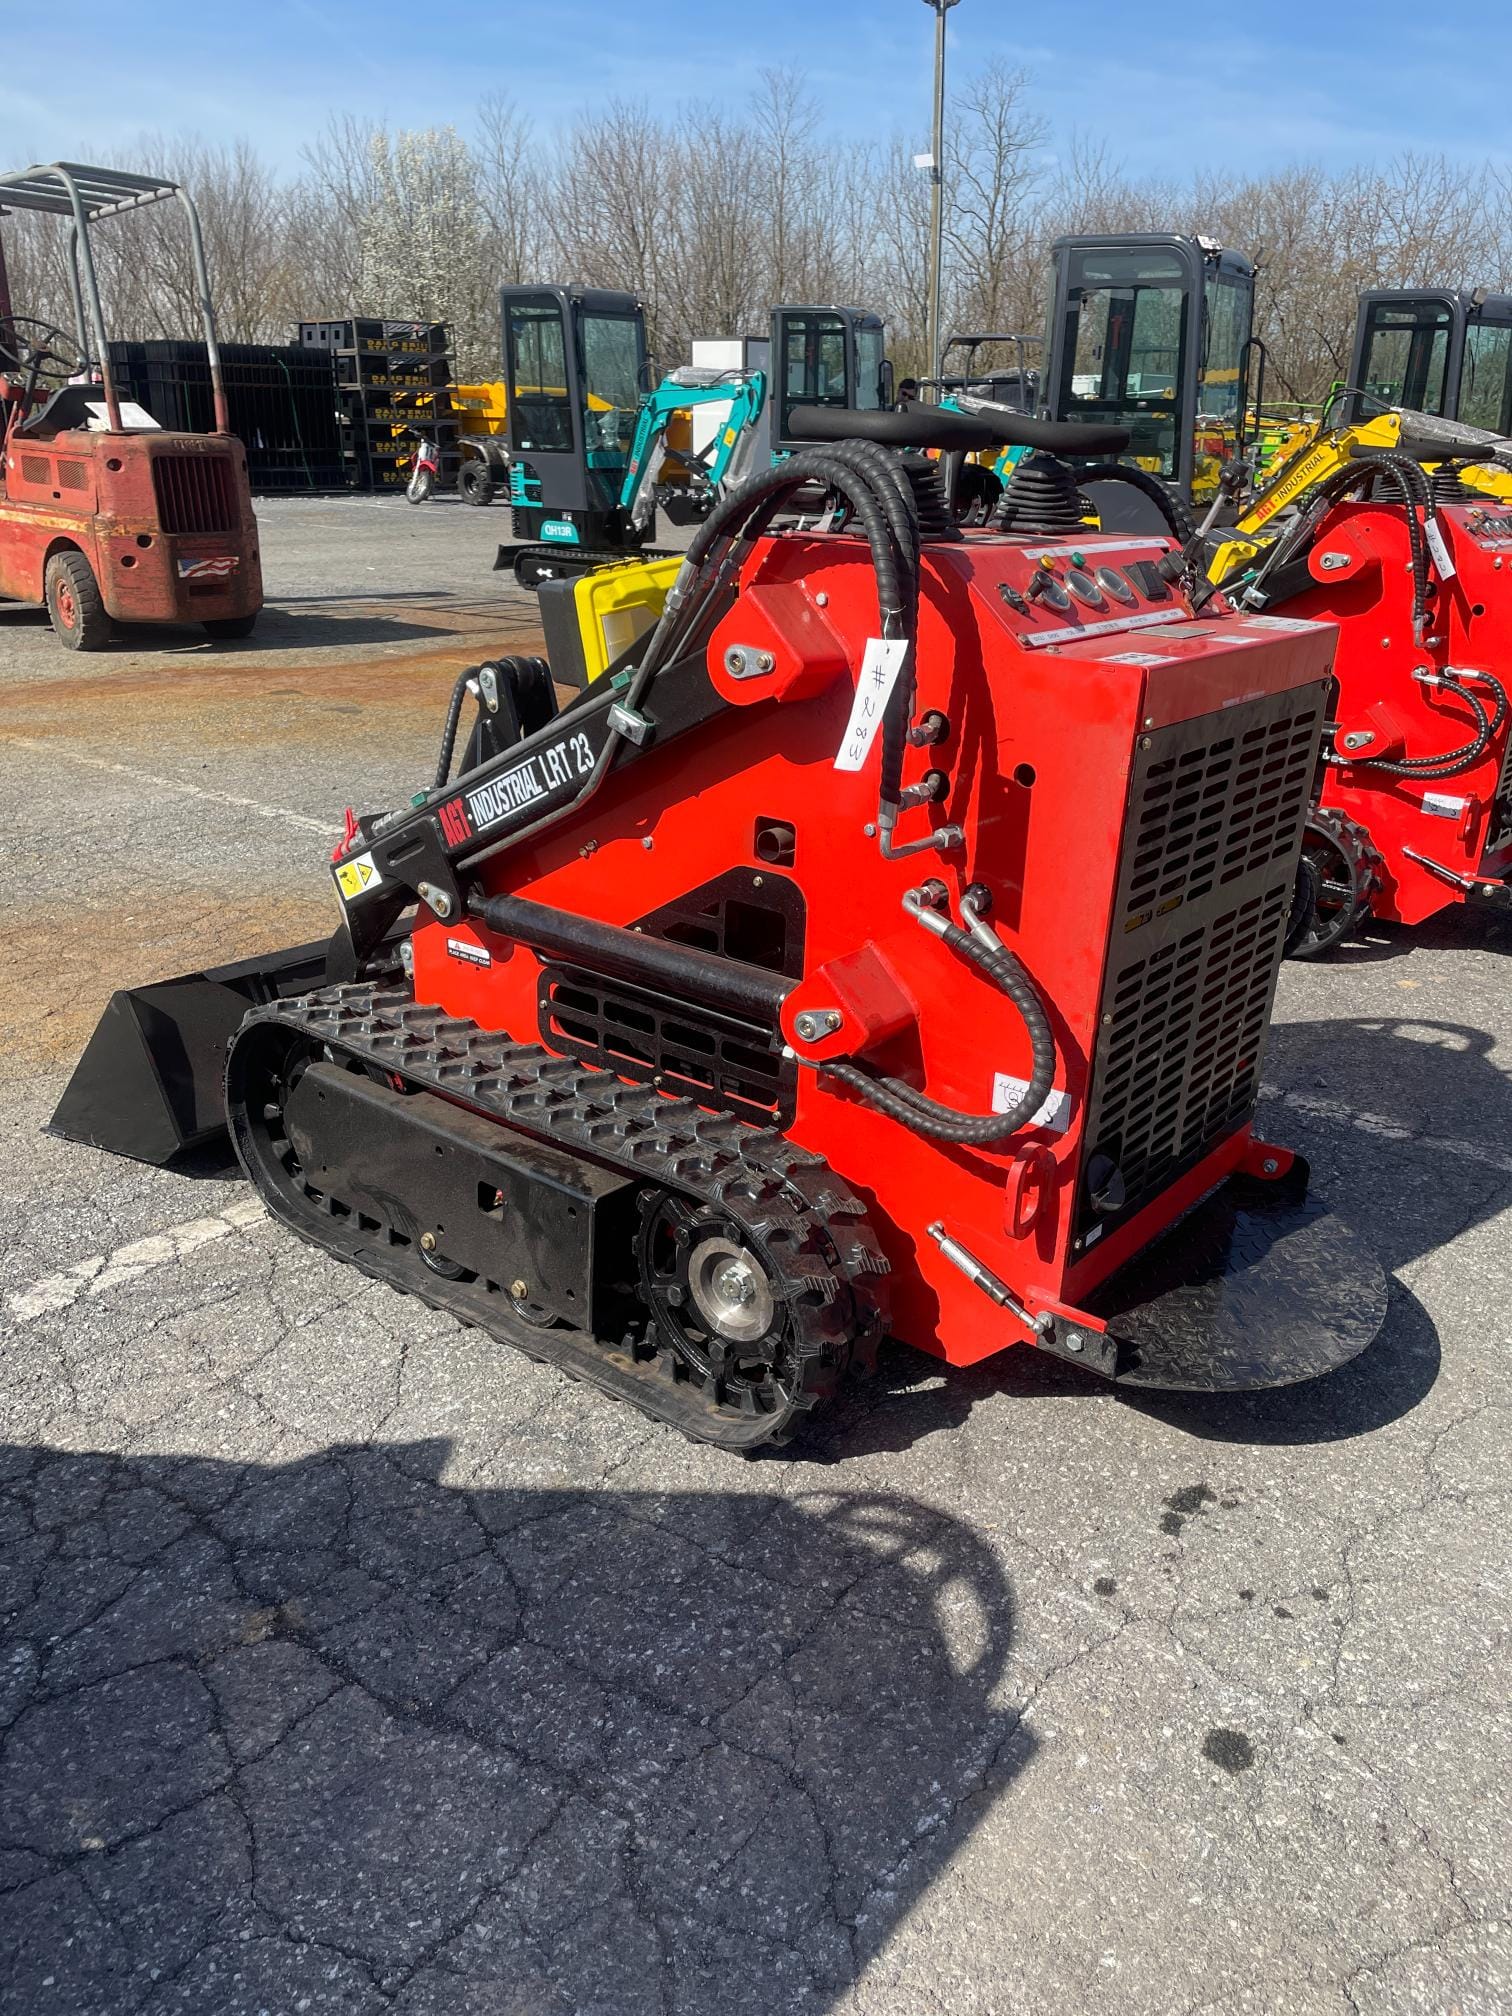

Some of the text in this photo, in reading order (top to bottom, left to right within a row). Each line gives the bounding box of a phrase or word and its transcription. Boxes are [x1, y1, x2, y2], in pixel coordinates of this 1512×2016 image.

[1277, 452, 1325, 500] INDUSTRIAL
[1255, 499, 1277, 521] AGT
[438, 732, 595, 847] AGT INDUSTRIAL LRT 23
